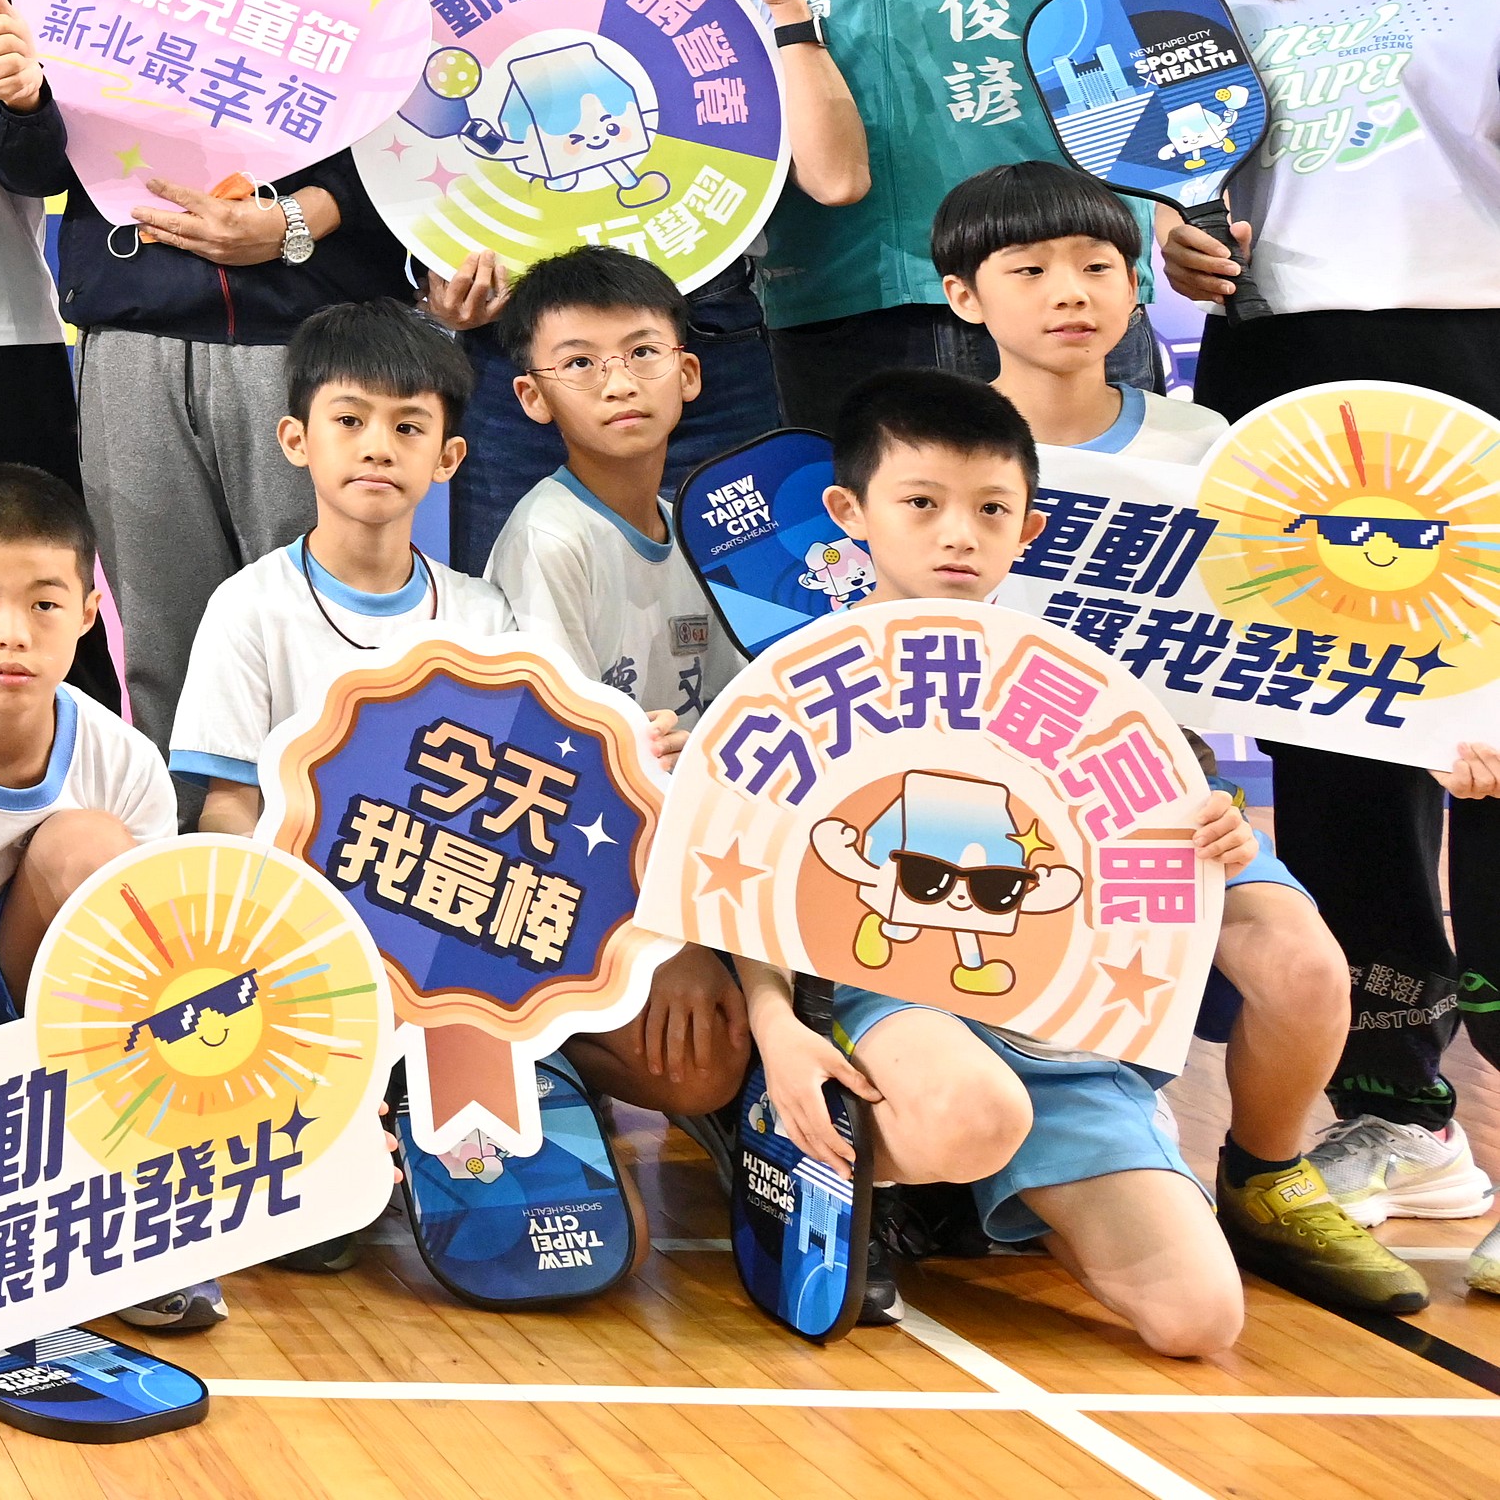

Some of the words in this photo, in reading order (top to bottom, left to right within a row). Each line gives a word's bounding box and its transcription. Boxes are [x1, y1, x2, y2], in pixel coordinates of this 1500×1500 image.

[1129, 45, 1157, 60] NEW
[1157, 36, 1187, 52] TAIPEI
[1188, 28, 1212, 42] CITY
[1338, 41, 1413, 58] EXERCISING
[1375, 34, 1414, 43] ENJOY
[1134, 39, 1219, 75] SPORTS
[706, 474, 755, 508] NEW
[701, 490, 766, 528] TAIPEI
[726, 504, 771, 536] CITY
[419, 722, 577, 855] 今天
[338, 799, 581, 966] 我最棒
[748, 1173, 795, 1213] SPORTS
[1279, 1178, 1317, 1203] FILA
[528, 1214, 579, 1235] CITY
[530, 1230, 604, 1253] TAIPEI
[538, 1247, 593, 1270] NEW
